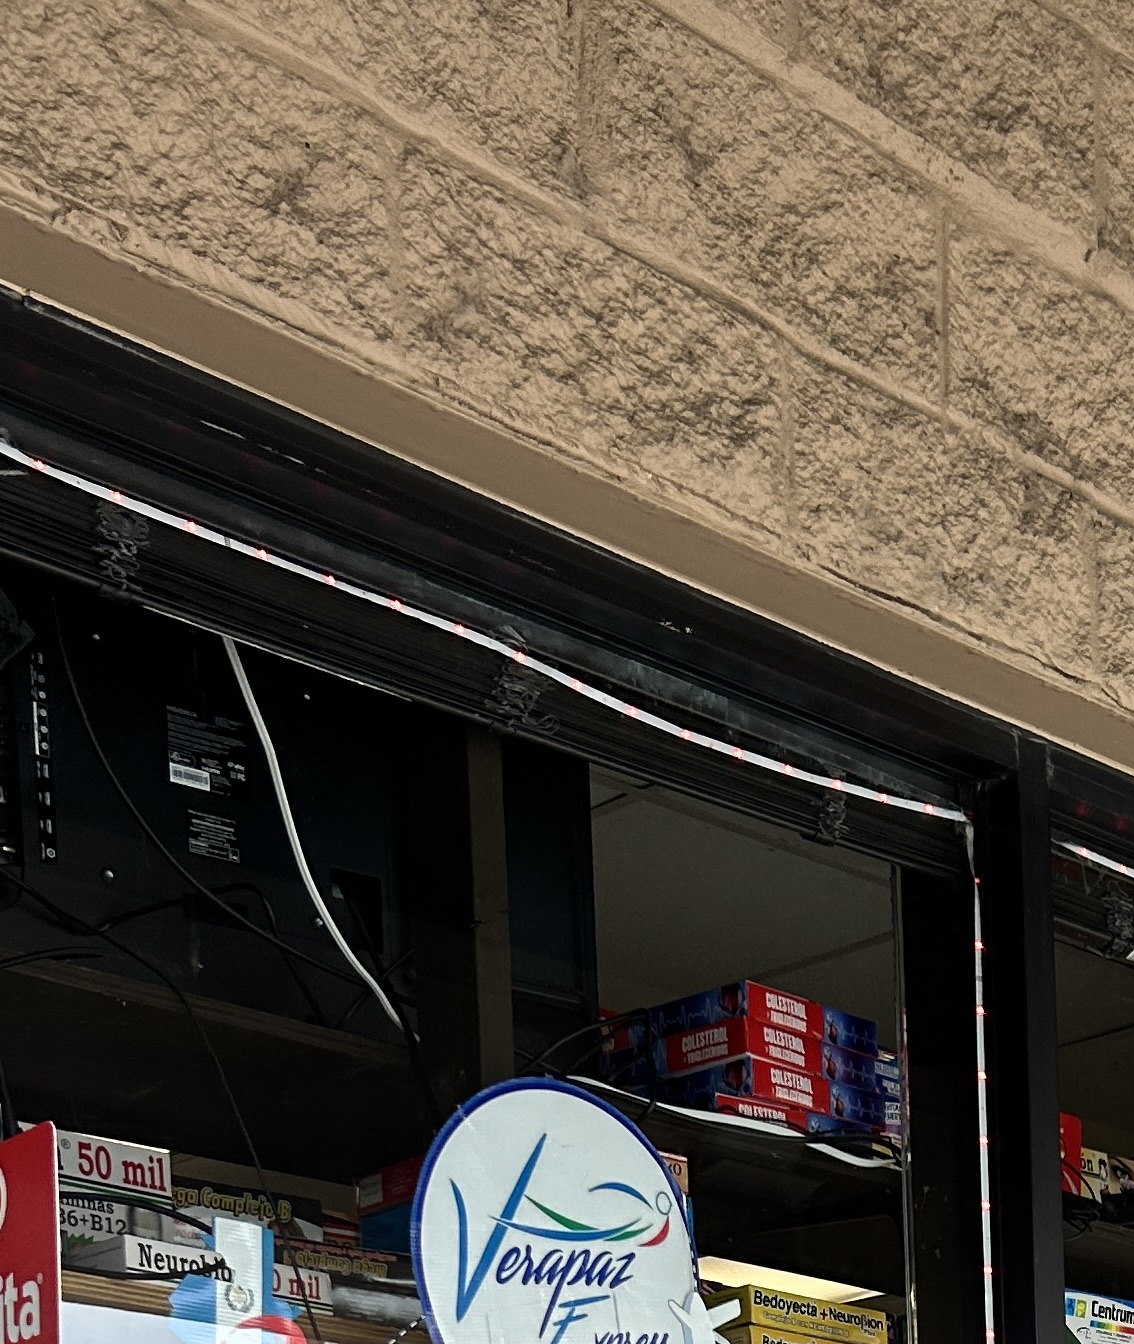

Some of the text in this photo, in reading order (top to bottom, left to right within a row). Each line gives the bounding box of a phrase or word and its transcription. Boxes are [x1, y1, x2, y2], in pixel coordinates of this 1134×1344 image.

[78, 1141, 167, 1192] 50 mil
[450, 1132, 635, 1337] Verapaz
[753, 1290, 818, 1318] Bedoyecta
